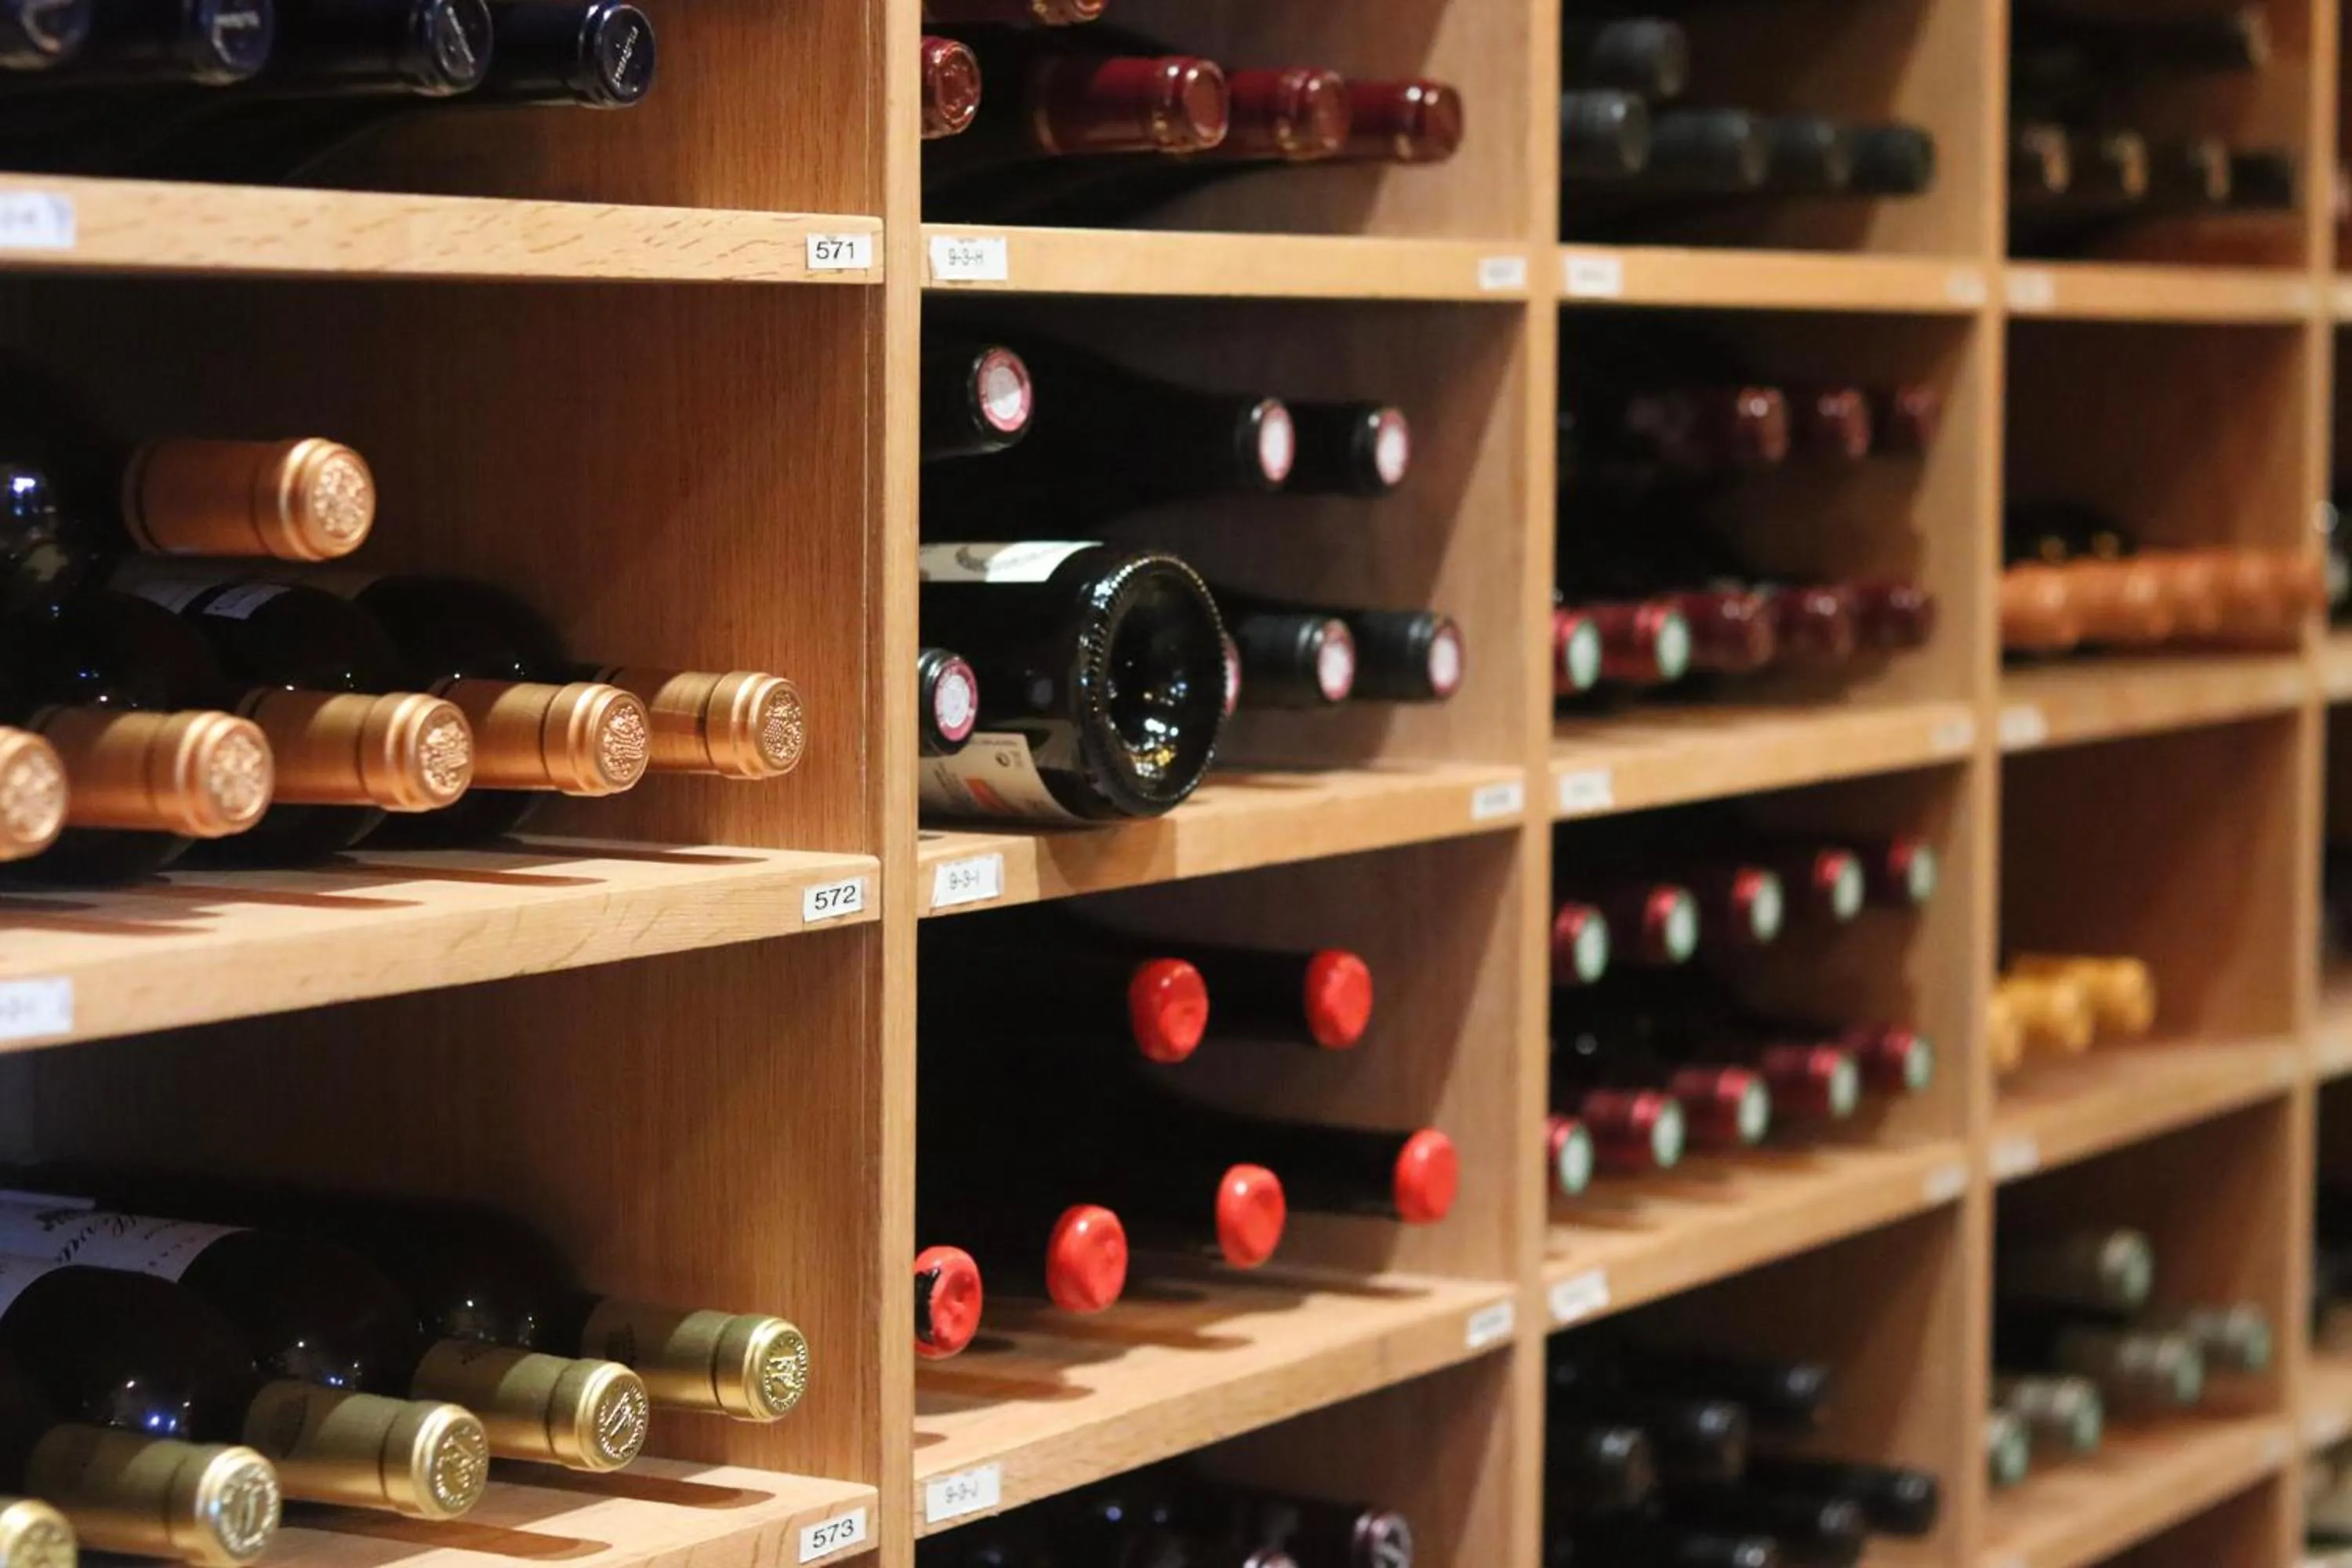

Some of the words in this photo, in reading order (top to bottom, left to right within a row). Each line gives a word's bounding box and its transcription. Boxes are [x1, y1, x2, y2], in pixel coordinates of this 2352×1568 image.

[816, 241, 854, 260] 571
[815, 884, 856, 910] 572
[813, 1519, 854, 1548] 573
